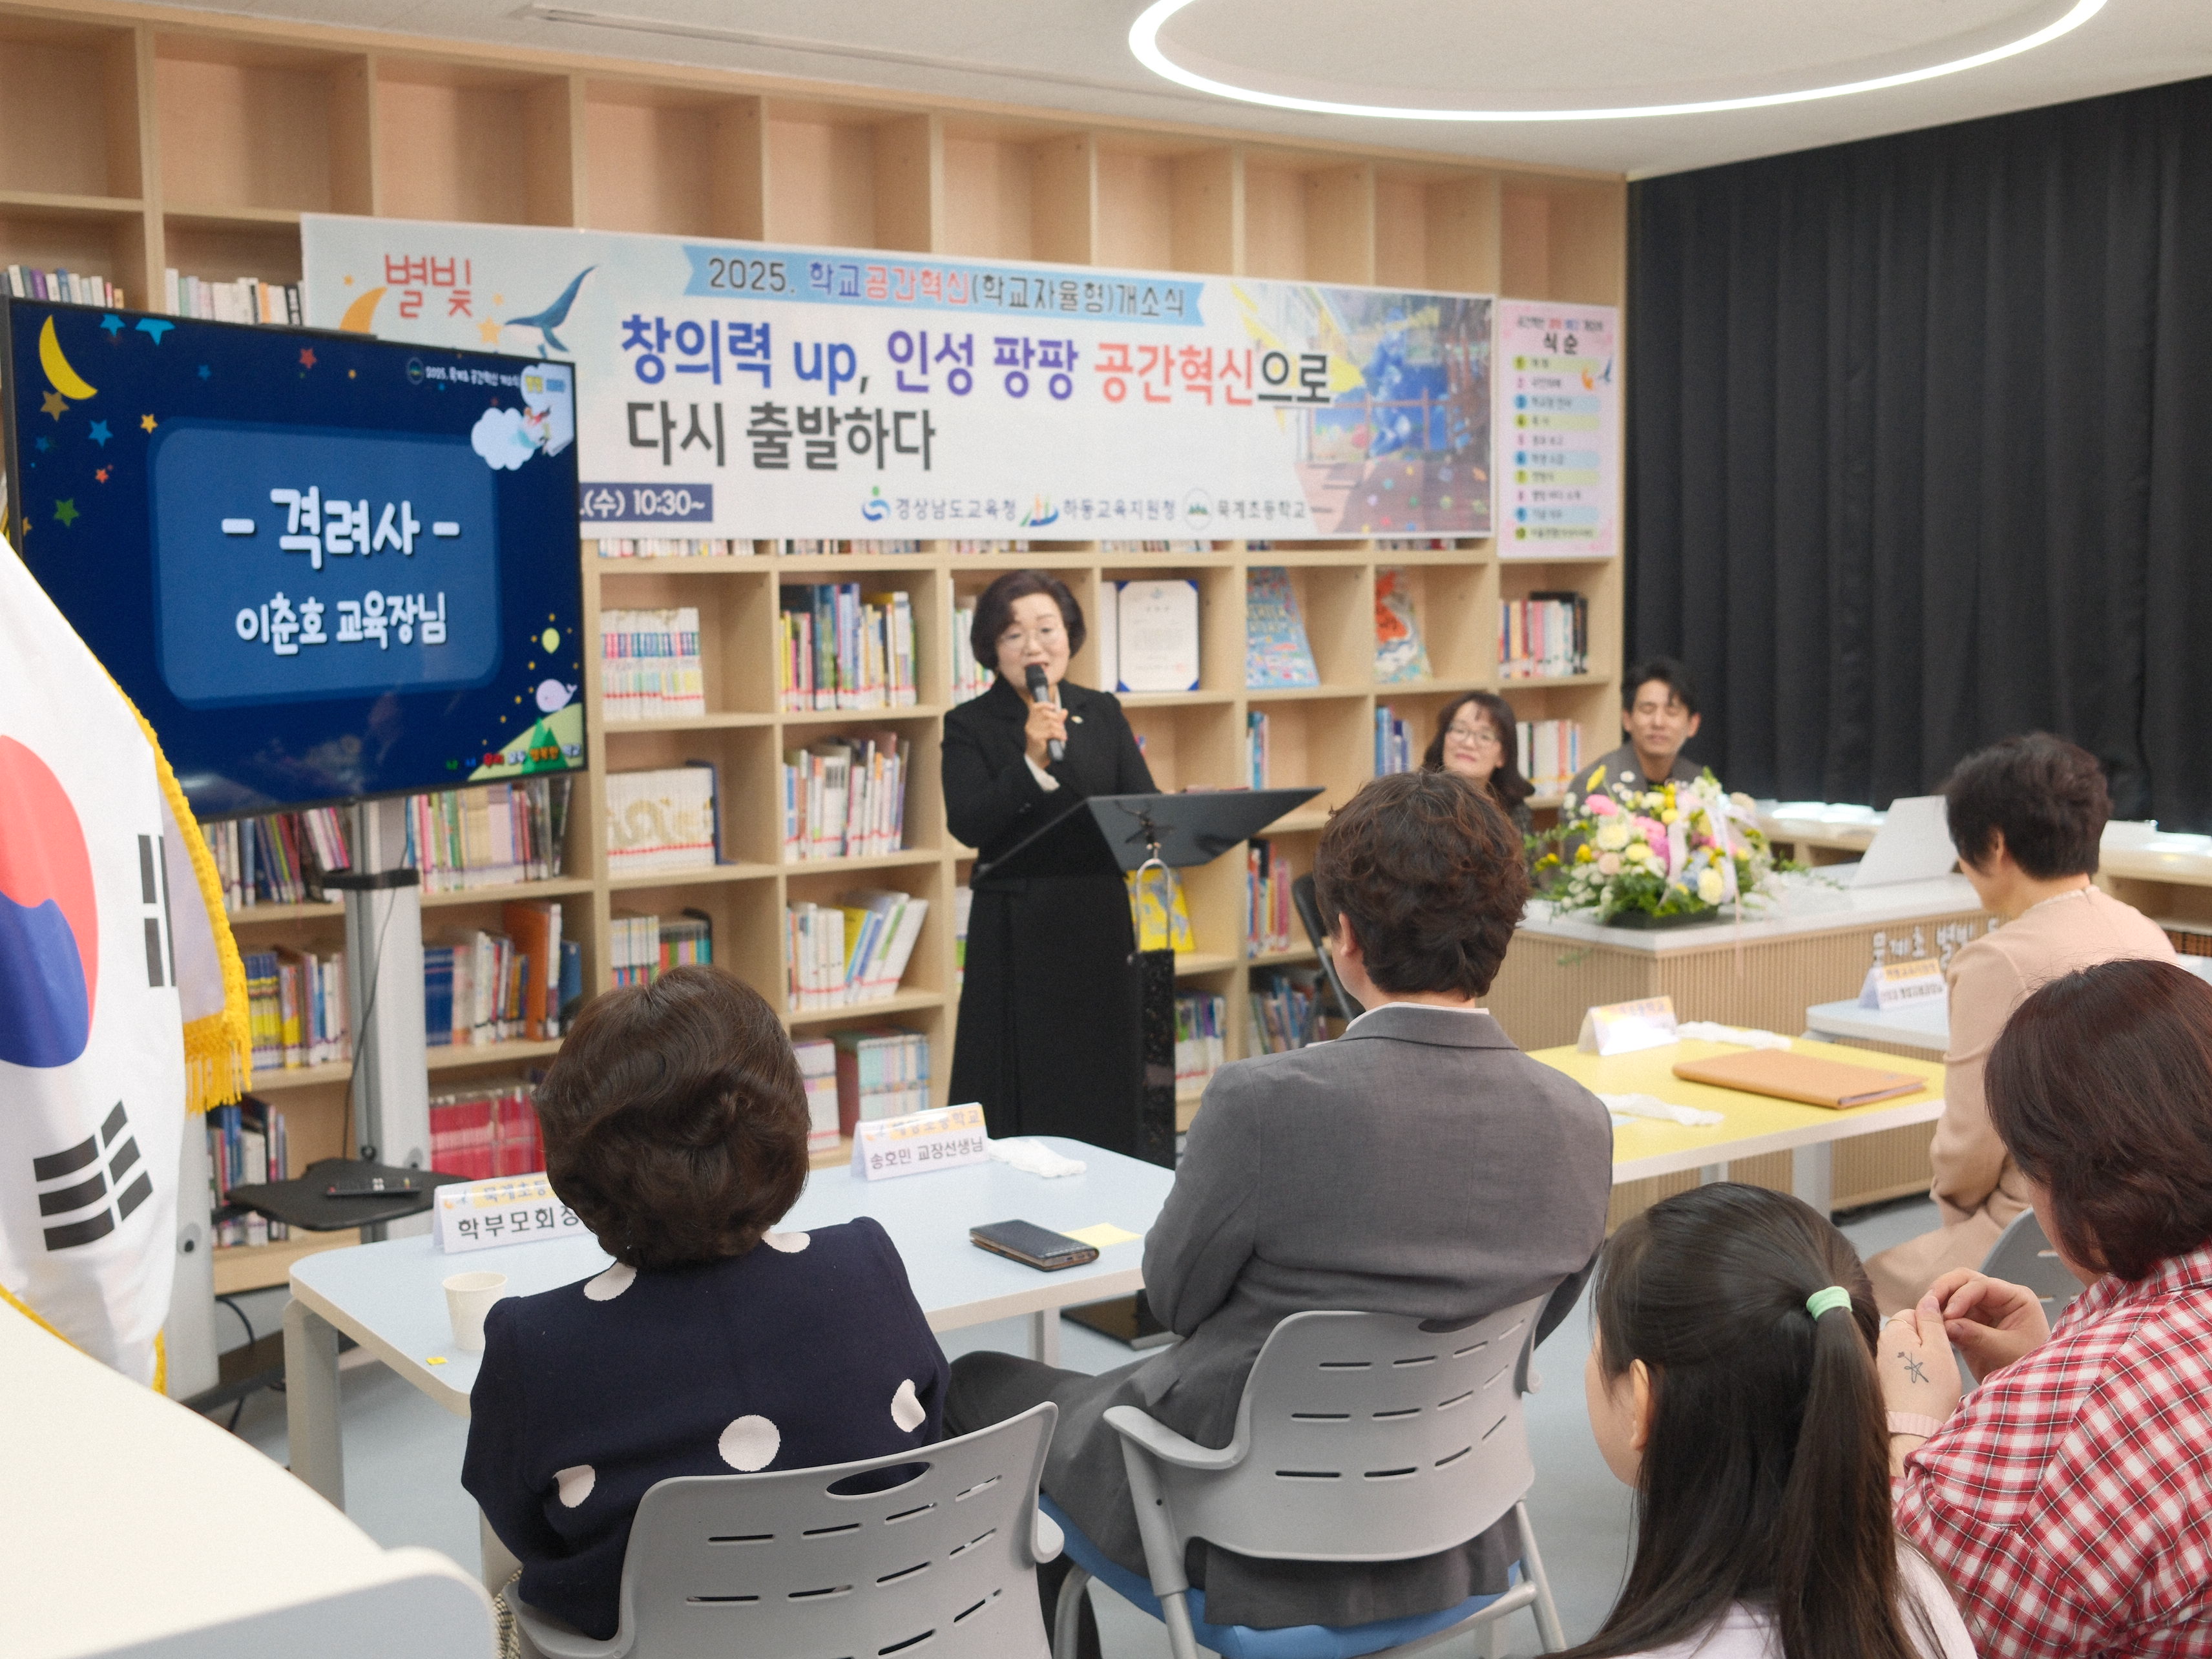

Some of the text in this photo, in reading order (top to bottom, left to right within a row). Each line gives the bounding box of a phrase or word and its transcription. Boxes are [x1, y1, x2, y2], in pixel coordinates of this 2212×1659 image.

[384, 254, 473, 318] 별빛
[709, 258, 795, 293] 2025.
[621, 314, 1331, 407] 창의력 up, 인성 팡팡 공간혁신으로
[627, 400, 935, 471] 다시 출발하다
[270, 485, 421, 570] 격려사
[632, 489, 705, 516] 10:30~
[897, 498, 1016, 521] 경상남도교육청
[235, 590, 447, 656] 이춘호 교육장님
[916, 1135, 984, 1161] 교장선생님
